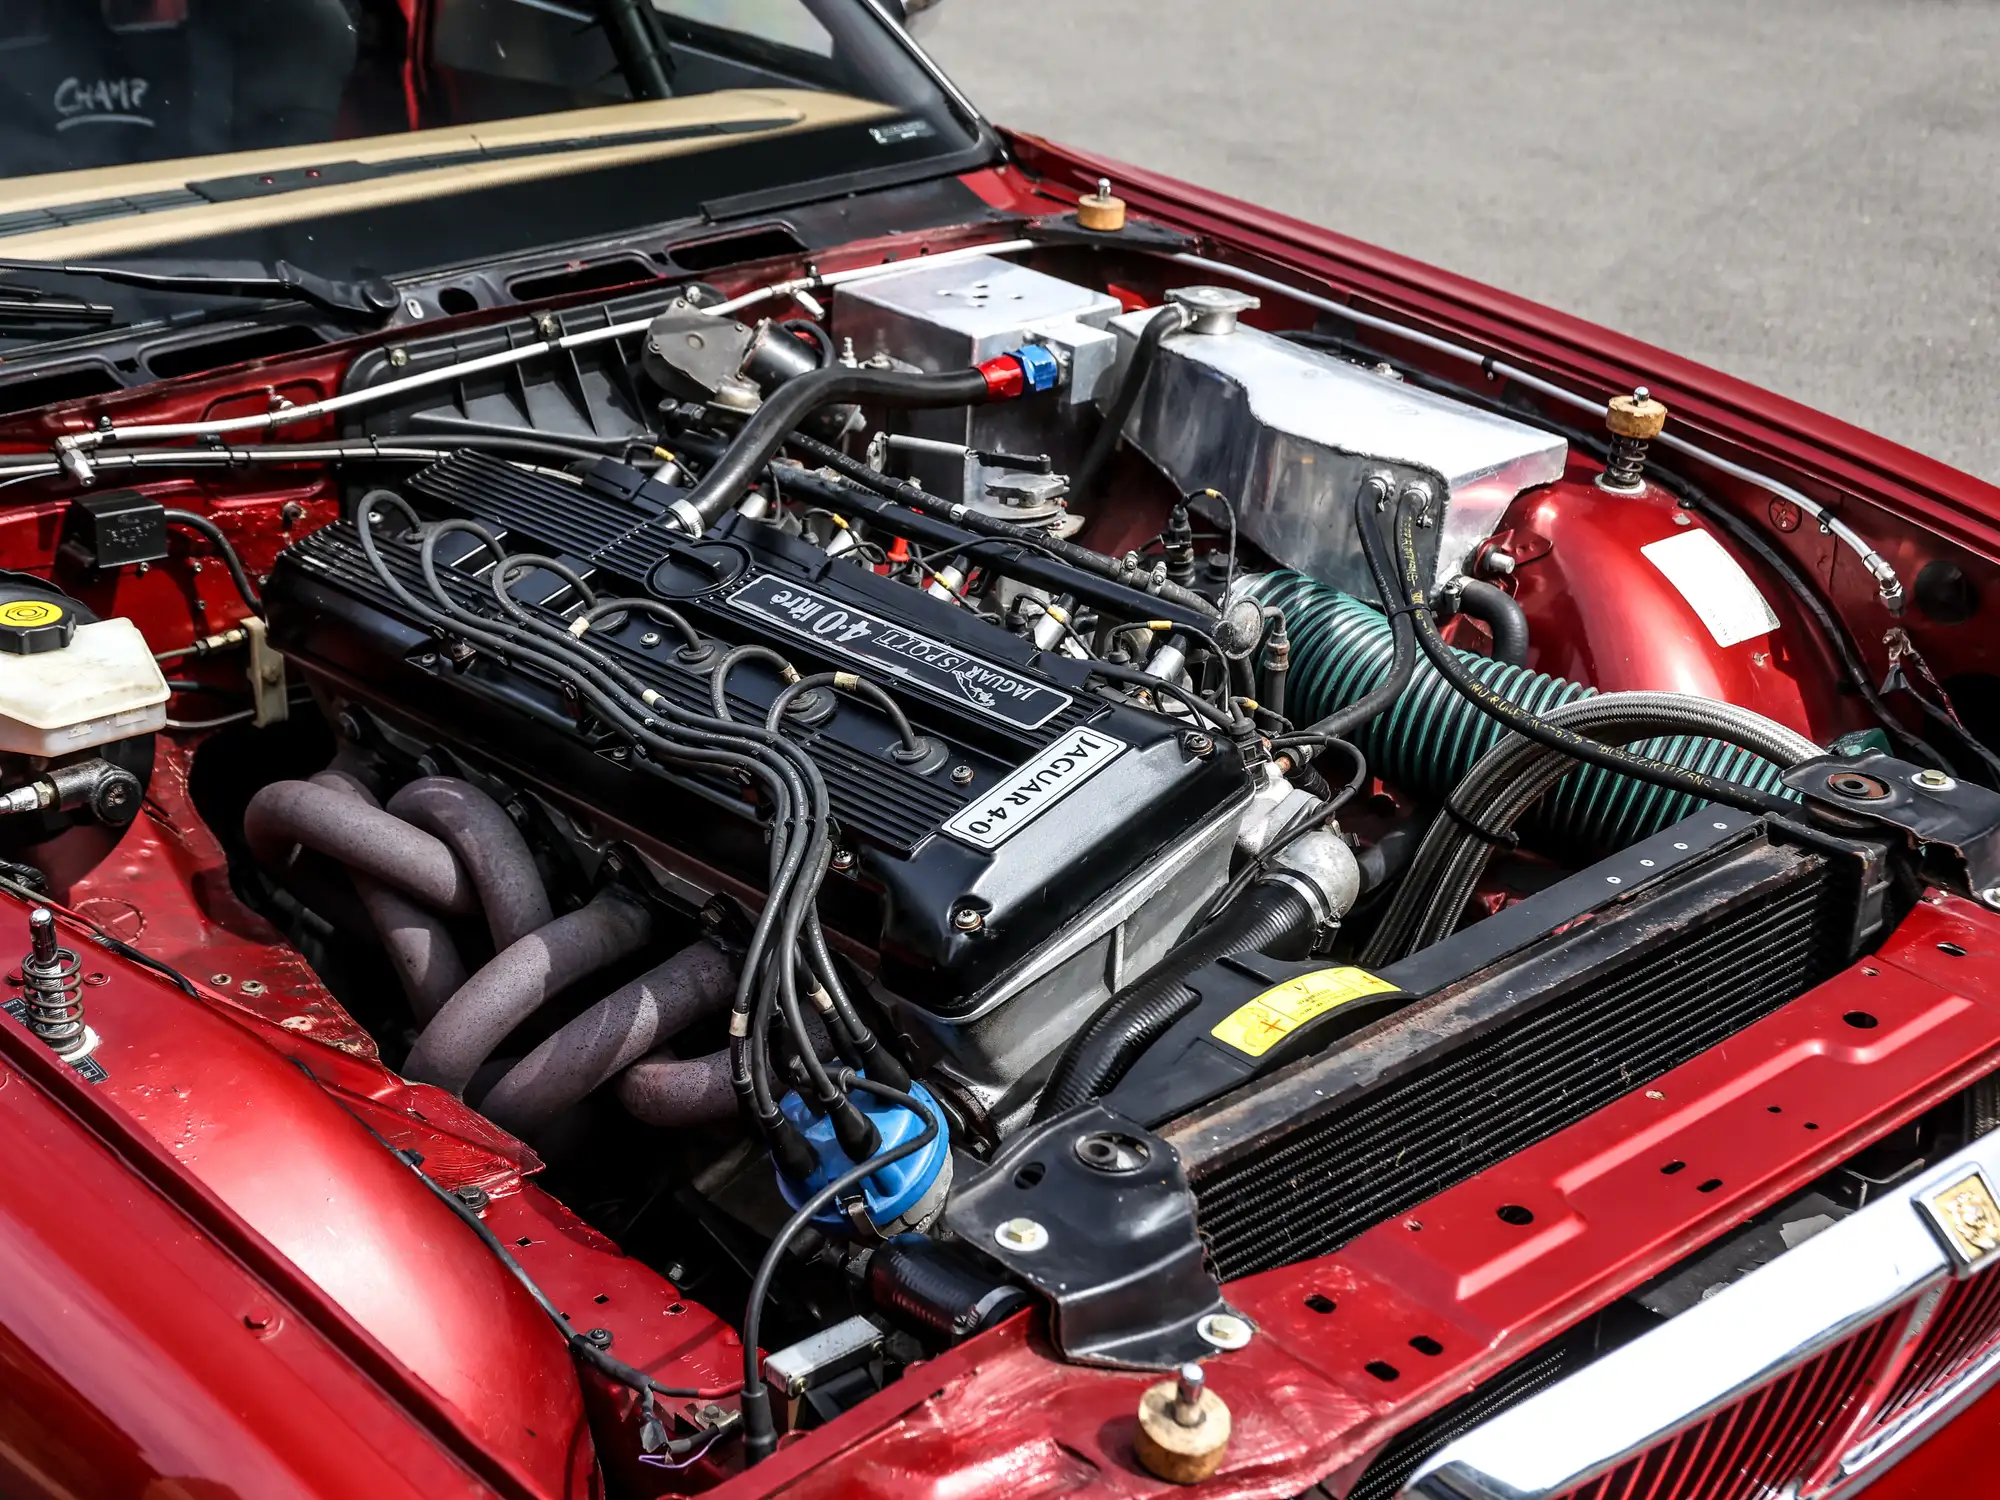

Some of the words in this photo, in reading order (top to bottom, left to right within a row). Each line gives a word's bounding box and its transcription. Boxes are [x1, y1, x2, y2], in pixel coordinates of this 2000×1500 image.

[770, 590, 826, 620] litre
[964, 665, 1041, 701] JAGUAR
[1003, 736, 1101, 806] JAGUAR
